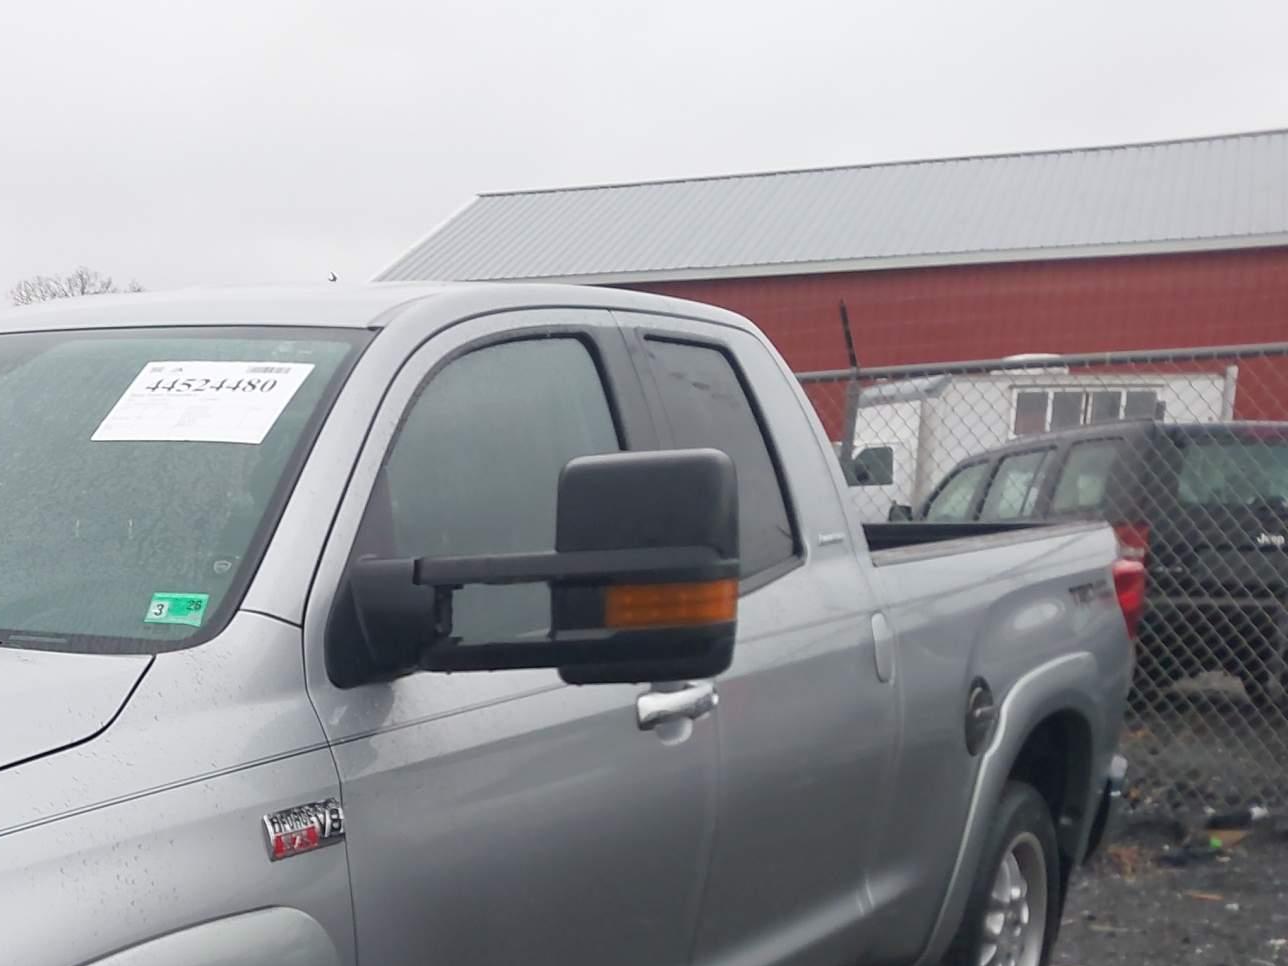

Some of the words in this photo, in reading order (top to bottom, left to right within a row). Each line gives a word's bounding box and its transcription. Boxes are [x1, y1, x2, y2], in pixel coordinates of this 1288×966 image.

[145, 378, 278, 393] 44524480
[154, 603, 165, 617] 3
[186, 600, 202, 611] 26
